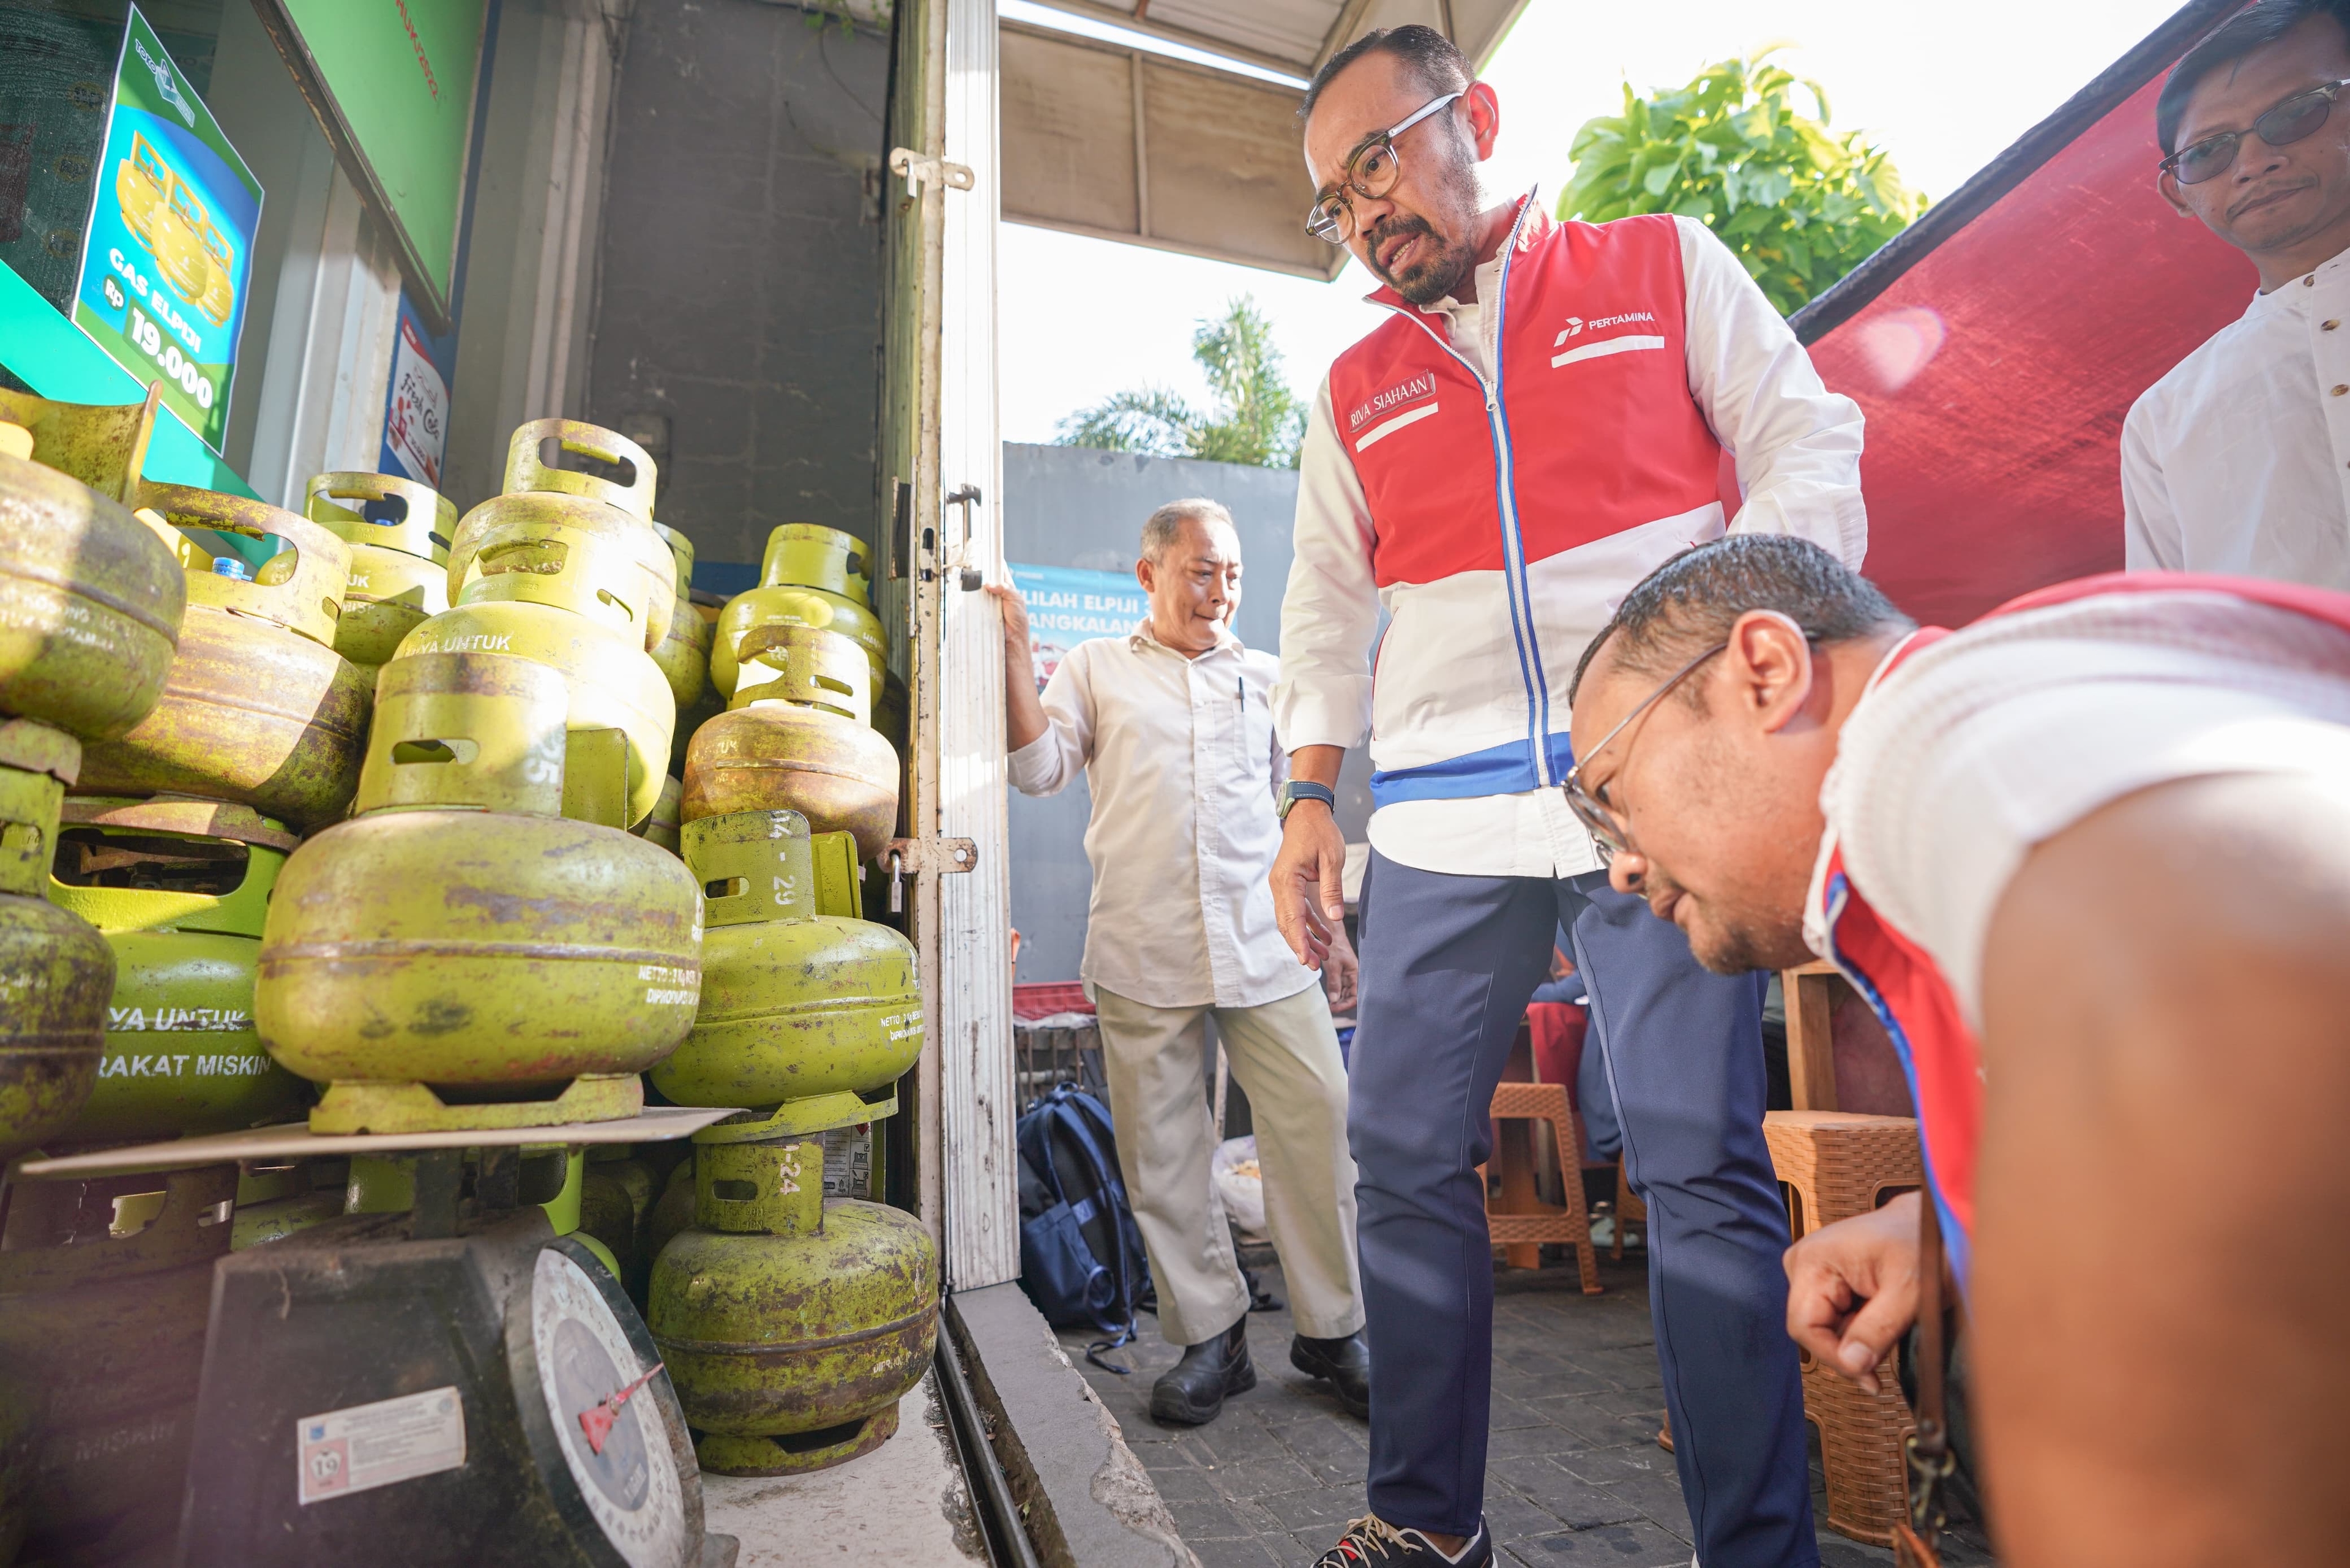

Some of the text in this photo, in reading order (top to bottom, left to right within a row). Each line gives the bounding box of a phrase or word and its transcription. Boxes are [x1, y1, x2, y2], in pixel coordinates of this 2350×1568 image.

[135, 39, 157, 74] TOKO
[110, 248, 202, 354] GAS ELPIJI
[1589, 312, 1653, 330] PERTAMINA
[105, 278, 213, 408] Rp 19.000
[1351, 376, 1428, 427] RIVA SIAHAAN
[1023, 589, 1078, 609] LILAH
[1084, 594, 1139, 613] ELPIJI
[1028, 613, 1138, 633] ANGKALAN
[444, 633, 512, 652] UNTUK
[108, 1007, 246, 1031] YA UNTUK
[880, 1015, 900, 1028] NETTO
[98, 1055, 272, 1079] RAKAT MISKIN
